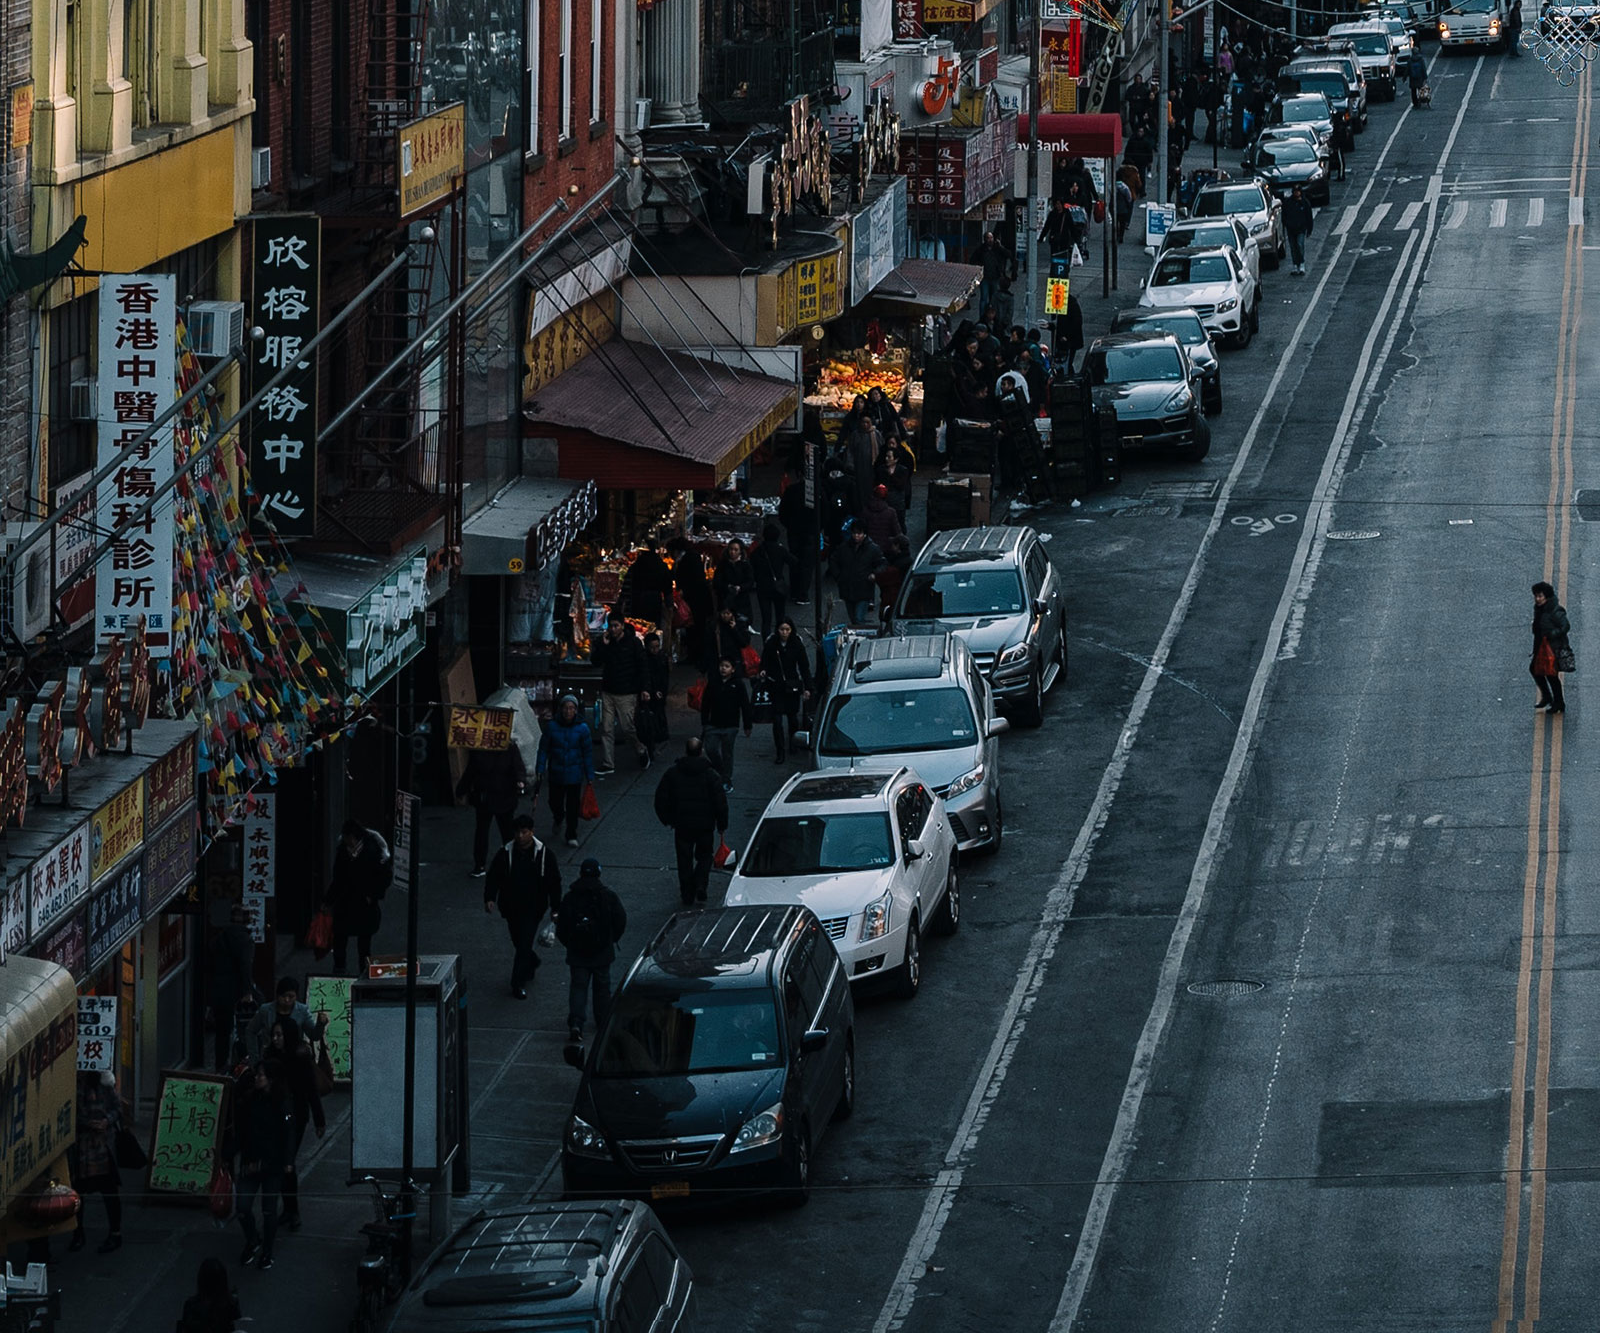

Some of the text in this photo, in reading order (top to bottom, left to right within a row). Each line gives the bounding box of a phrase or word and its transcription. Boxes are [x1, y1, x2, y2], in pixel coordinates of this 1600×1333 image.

[111, 282, 161, 608] 香港中醫骨傷科診所
[509, 560, 523, 570] 59
